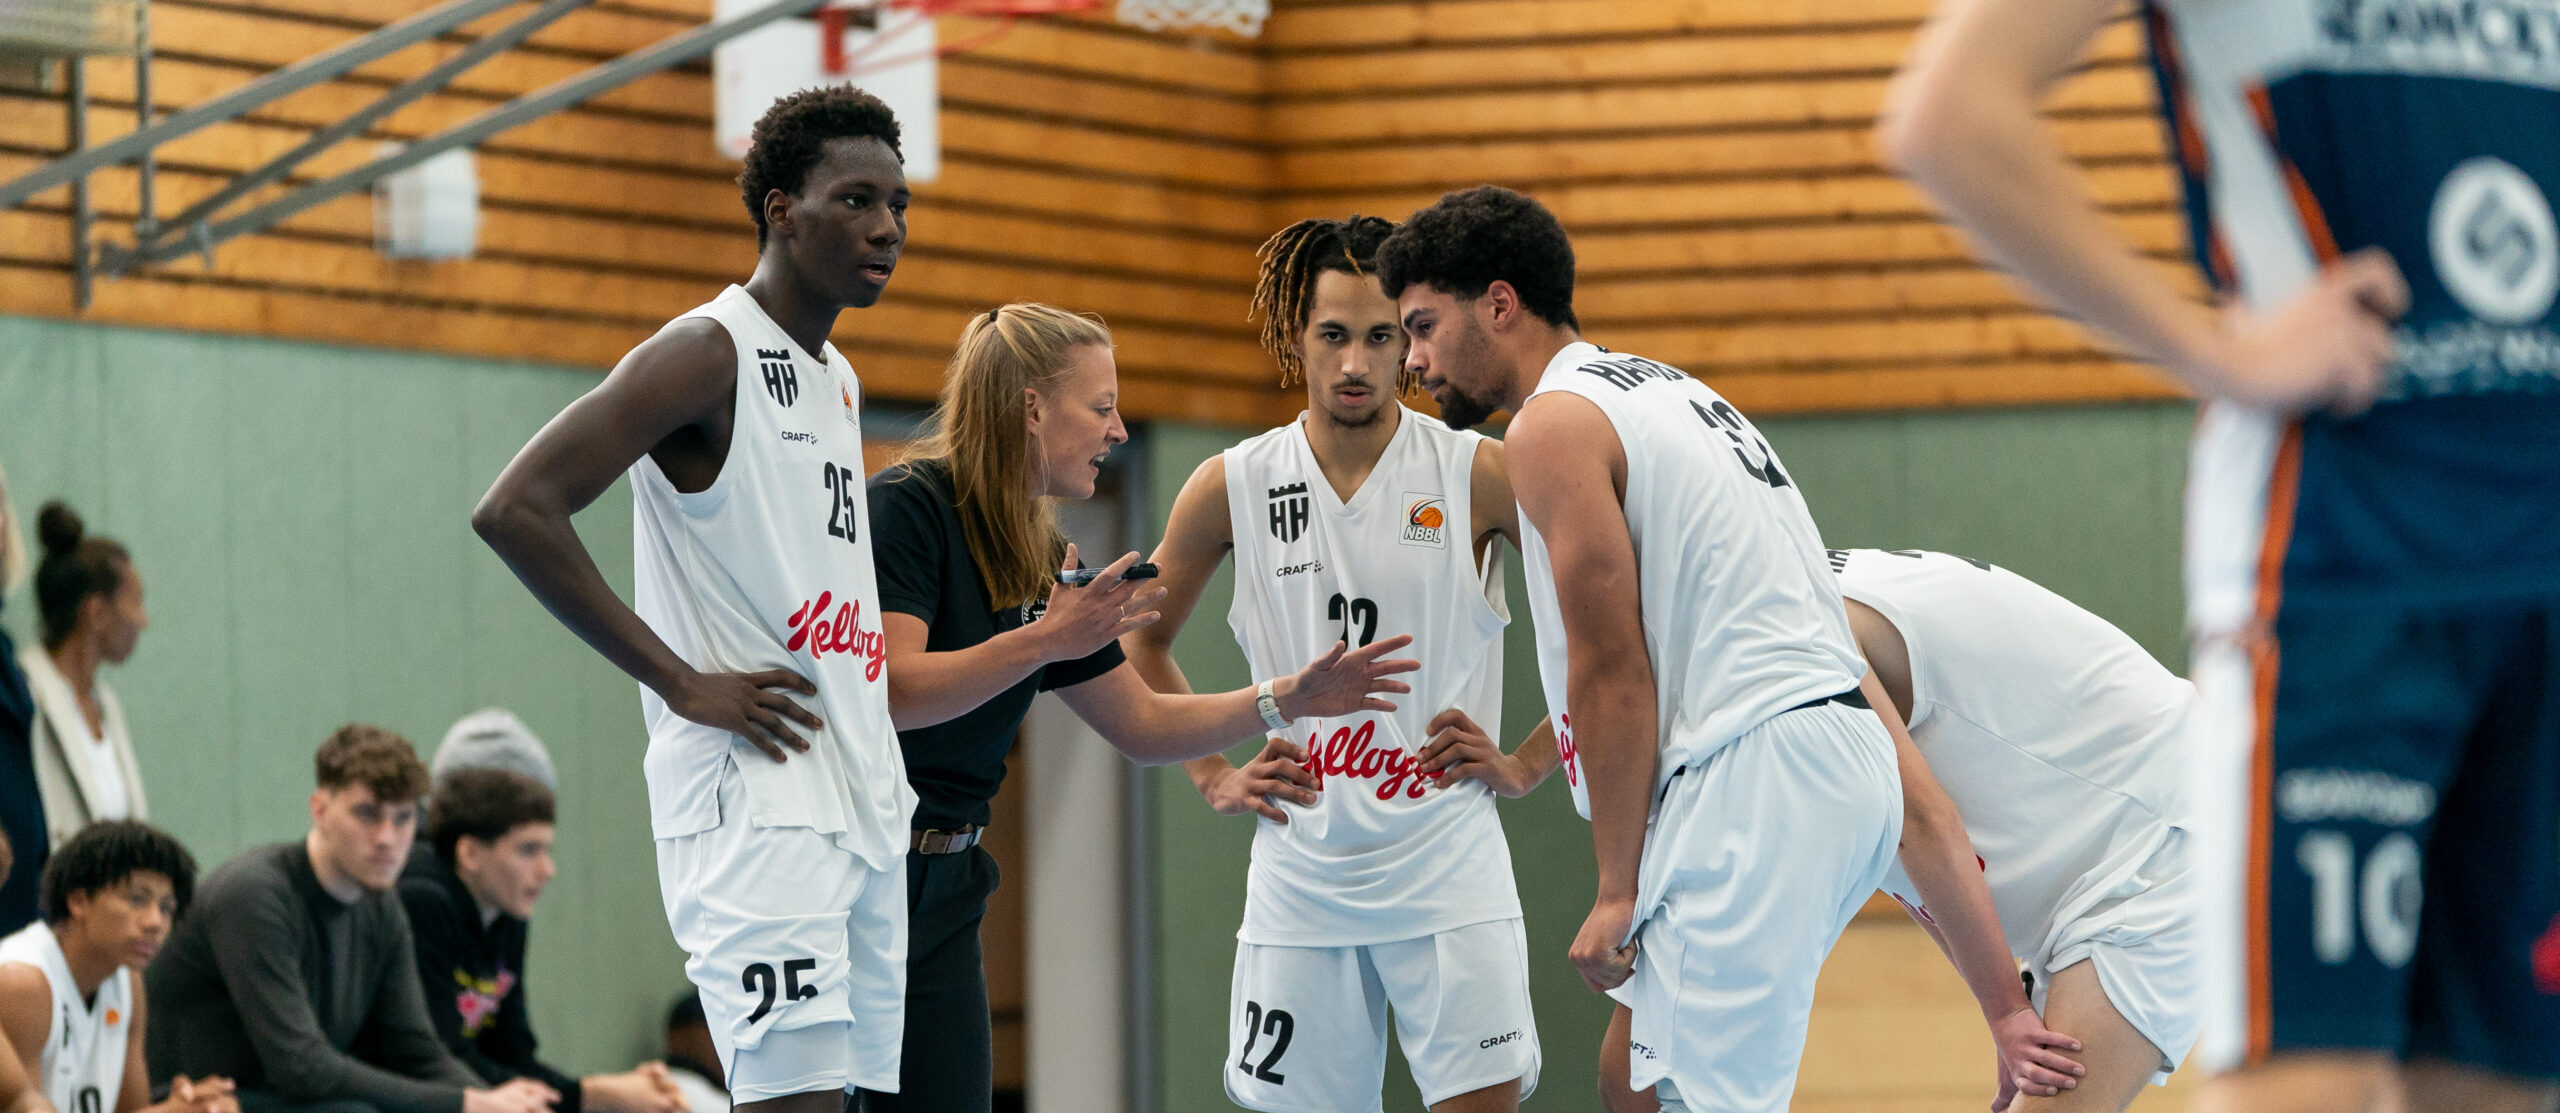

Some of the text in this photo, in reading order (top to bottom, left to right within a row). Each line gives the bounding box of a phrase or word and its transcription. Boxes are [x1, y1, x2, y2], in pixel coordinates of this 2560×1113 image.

[781, 431, 810, 444] CRAFT
[824, 461, 856, 544] 25
[1404, 525, 1442, 544] NBBL
[1276, 561, 1314, 578] CRAFT
[2297, 828, 2424, 969] 10
[742, 958, 818, 1025] 25
[1238, 999, 1295, 1086] 22
[1480, 1031, 1518, 1049] CRAFT
